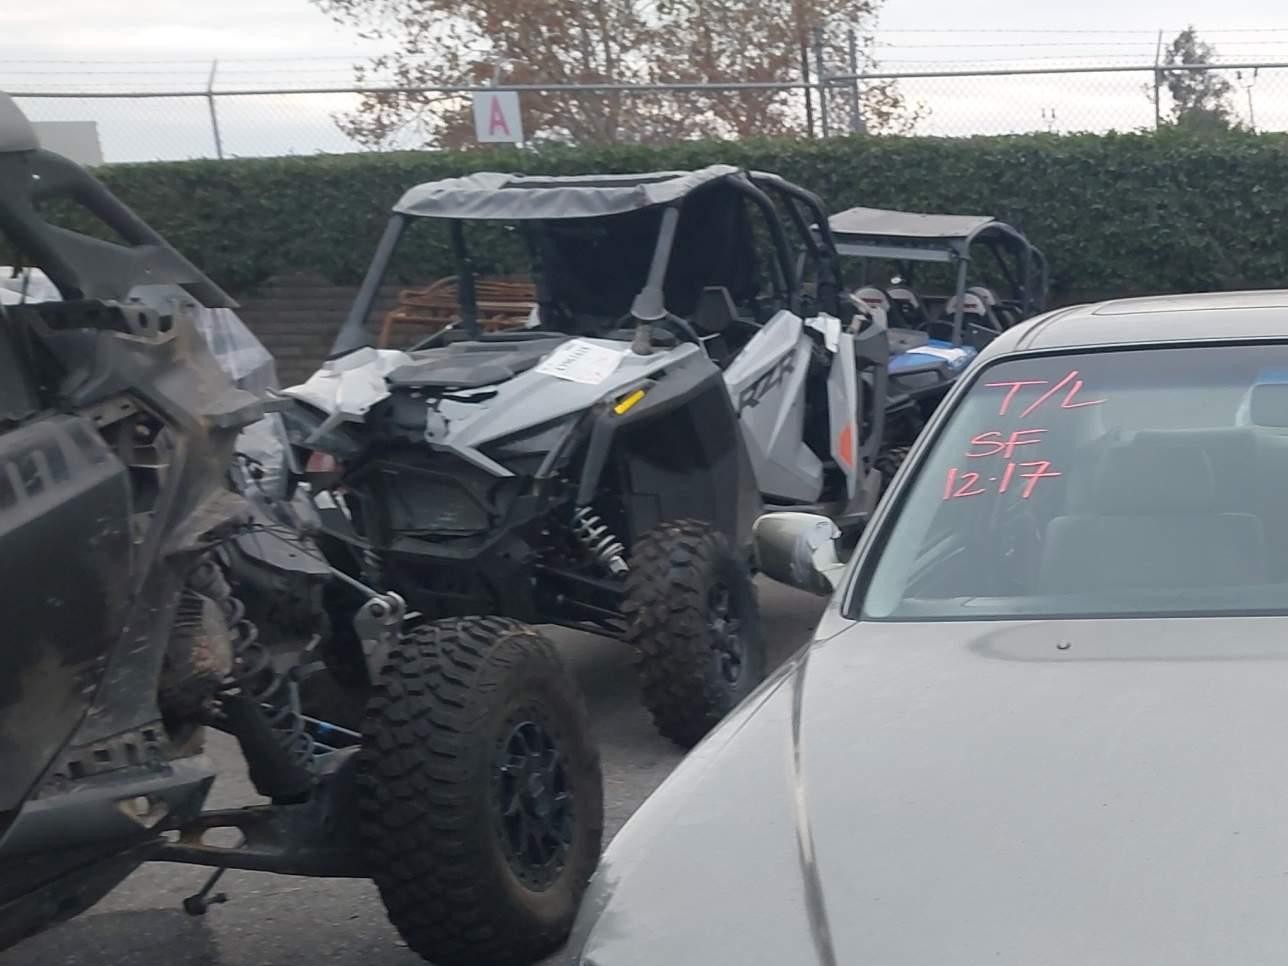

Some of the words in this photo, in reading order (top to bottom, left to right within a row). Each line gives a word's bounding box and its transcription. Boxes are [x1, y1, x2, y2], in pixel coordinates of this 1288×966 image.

[489, 95, 511, 136] A
[738, 347, 798, 411] RZR
[984, 371, 1108, 418] T/L
[965, 429, 1048, 458] SF
